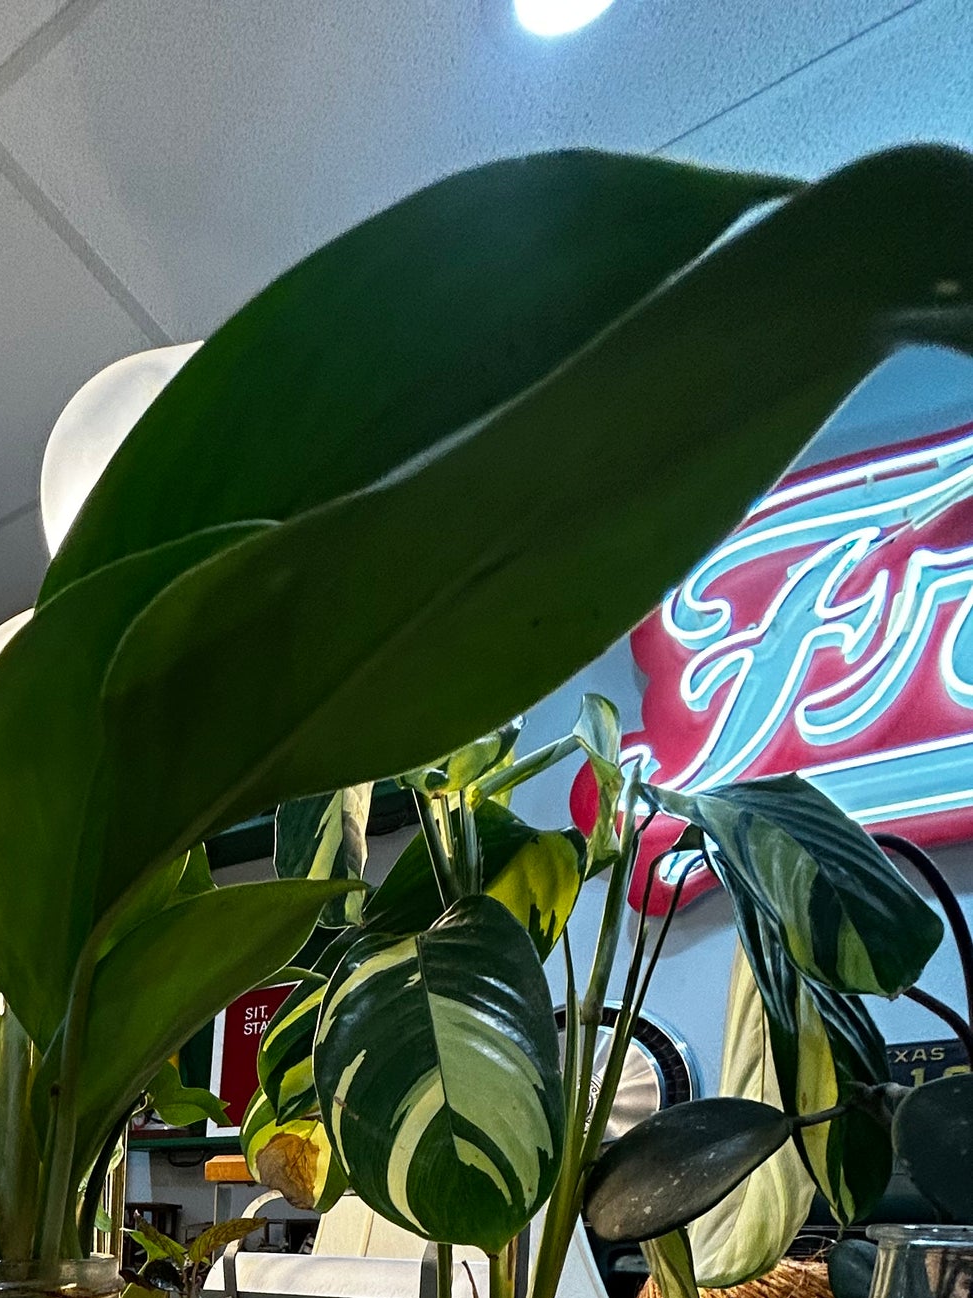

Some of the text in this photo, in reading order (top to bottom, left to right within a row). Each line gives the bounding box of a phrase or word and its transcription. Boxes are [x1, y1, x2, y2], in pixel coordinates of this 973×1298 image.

[244, 1005, 269, 1020] SIT,
[243, 1020, 271, 1035] STA
[886, 1047, 946, 1063] XAS
